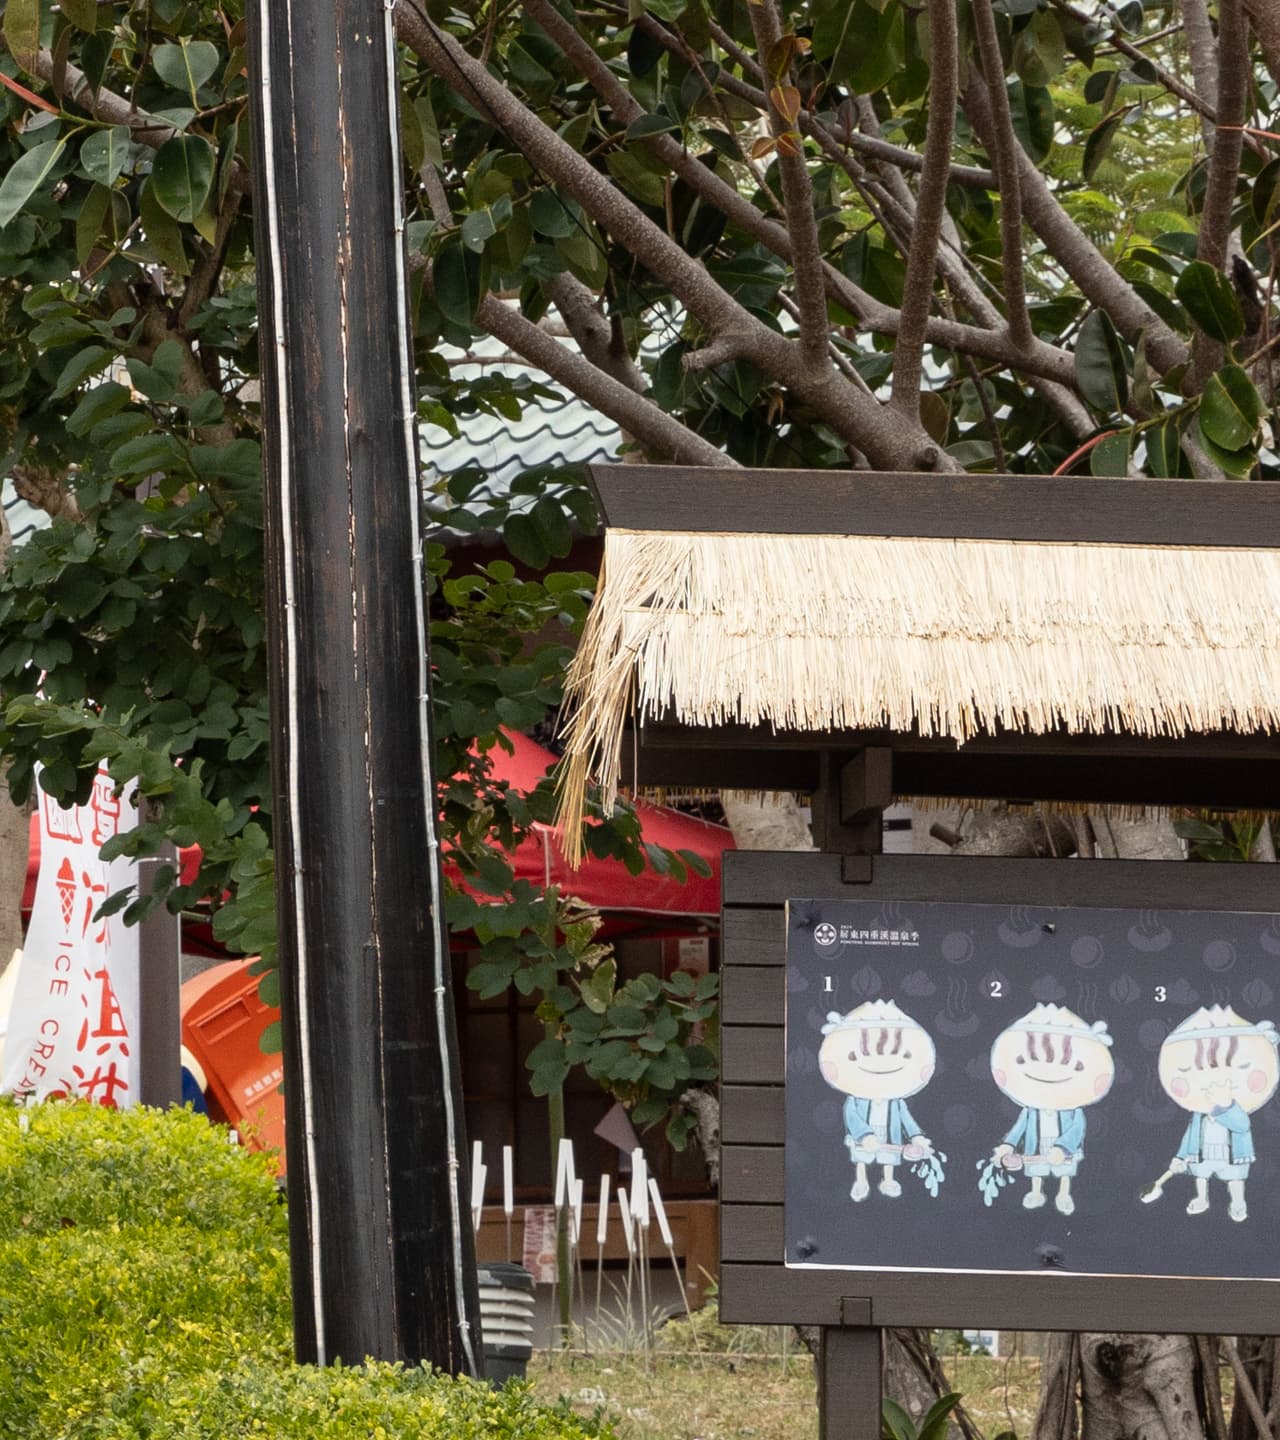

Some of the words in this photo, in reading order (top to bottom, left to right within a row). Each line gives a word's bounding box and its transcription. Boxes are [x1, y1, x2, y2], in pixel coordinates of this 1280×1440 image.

[49, 941, 73, 997] ICE
[823, 976, 834, 993] 1
[990, 981, 1002, 997] 2
[1154, 986, 1167, 1002] 3
